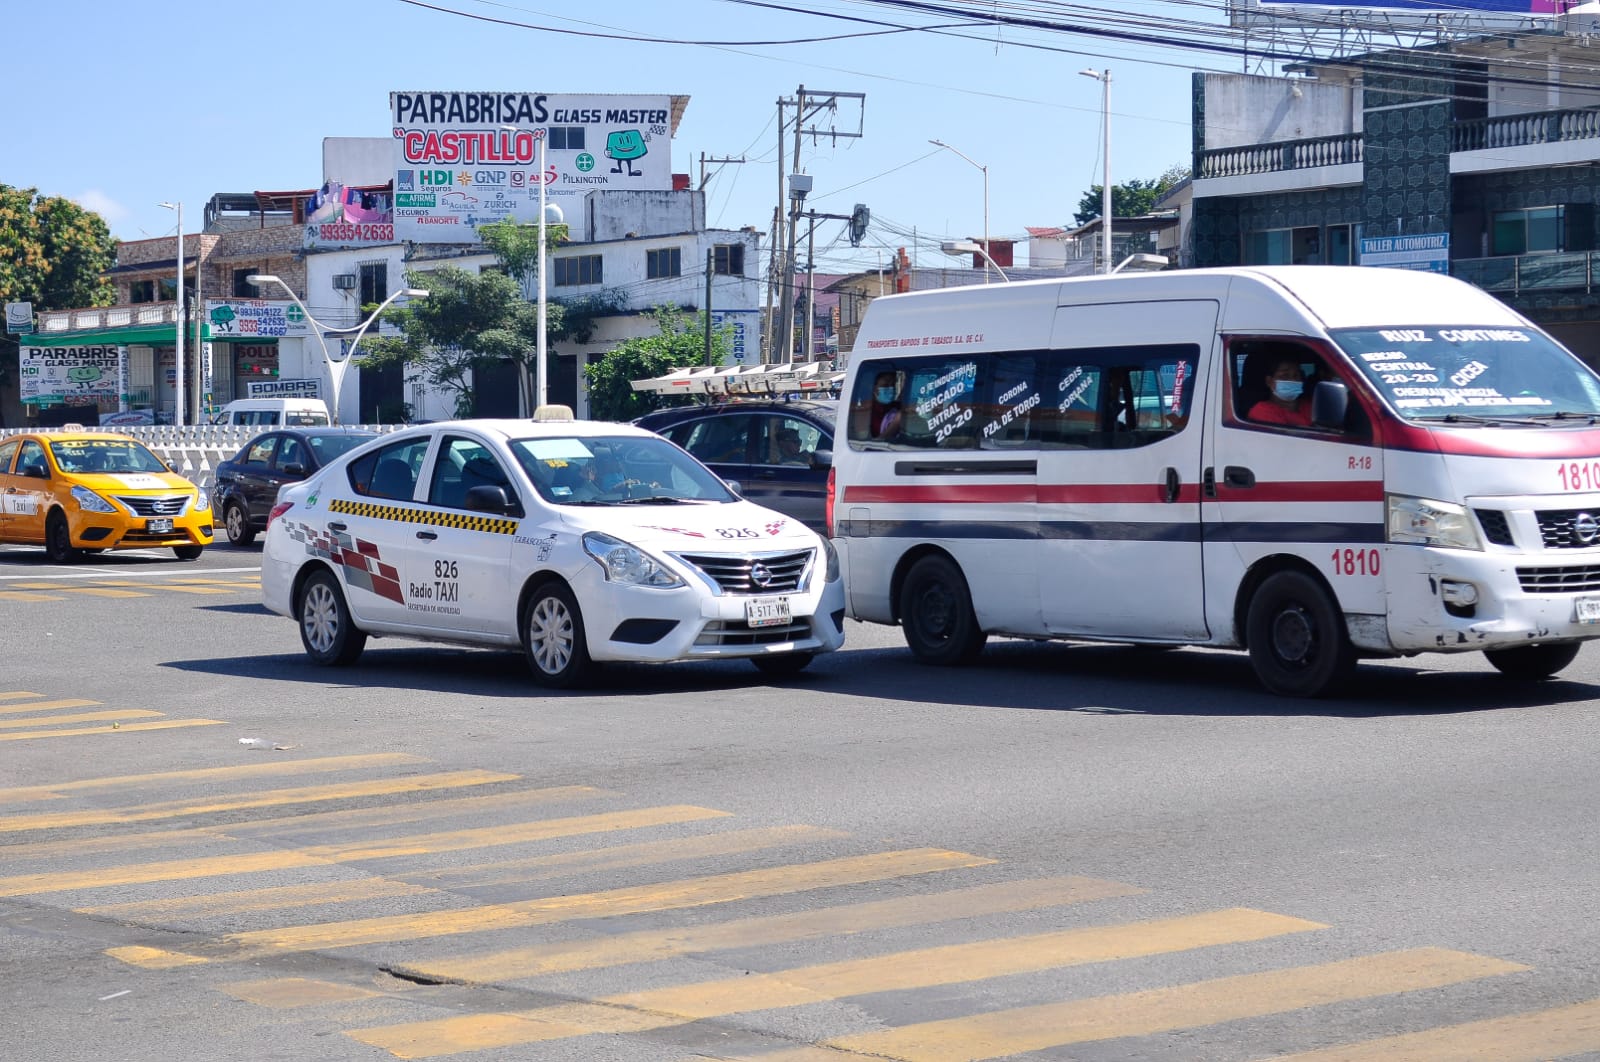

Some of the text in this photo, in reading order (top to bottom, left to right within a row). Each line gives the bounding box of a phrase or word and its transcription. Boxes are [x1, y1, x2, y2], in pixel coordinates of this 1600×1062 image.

[397, 94, 667, 124] PARABRISAS GLASS MASTER
[420, 170, 453, 186] HDI
[474, 171, 506, 184] GNP
[425, 217, 460, 225] BANORTE
[321, 224, 394, 240] 9933542633
[1364, 235, 1445, 253] TALLER AUTOMOTRIZ
[239, 320, 257, 332] 9933
[257, 317, 286, 327] 542633
[257, 327, 287, 336] 544667
[1378, 329, 1531, 342] RUIZ CORTINES
[867, 340, 899, 349] TRANSPORTES
[931, 336, 953, 345] TABASCO
[965, 334, 973, 343] DE
[21, 367, 39, 375] HDI
[1369, 362, 1436, 372] CENTRAL
[1450, 360, 1489, 387] CICEA
[1059, 366, 1083, 392] CEDIS
[1381, 373, 1440, 384] 20-20
[252, 381, 318, 394] BOMBAS
[998, 381, 1028, 405] CORONA
[1059, 376, 1093, 413] SORIANA
[917, 382, 964, 416] MERCADO
[927, 403, 961, 431] ENTRAL
[1001, 410, 1013, 426] DE
[1013, 393, 1040, 418] TOROS
[935, 409, 973, 443] 20-20
[1348, 456, 1372, 469] R-18
[1558, 462, 1600, 490] 1810
[13, 499, 26, 512] Taxi
[715, 527, 760, 539] 826
[434, 559, 459, 579] 826
[1331, 548, 1380, 577] 1810
[410, 581, 459, 602] Radio TAXI
